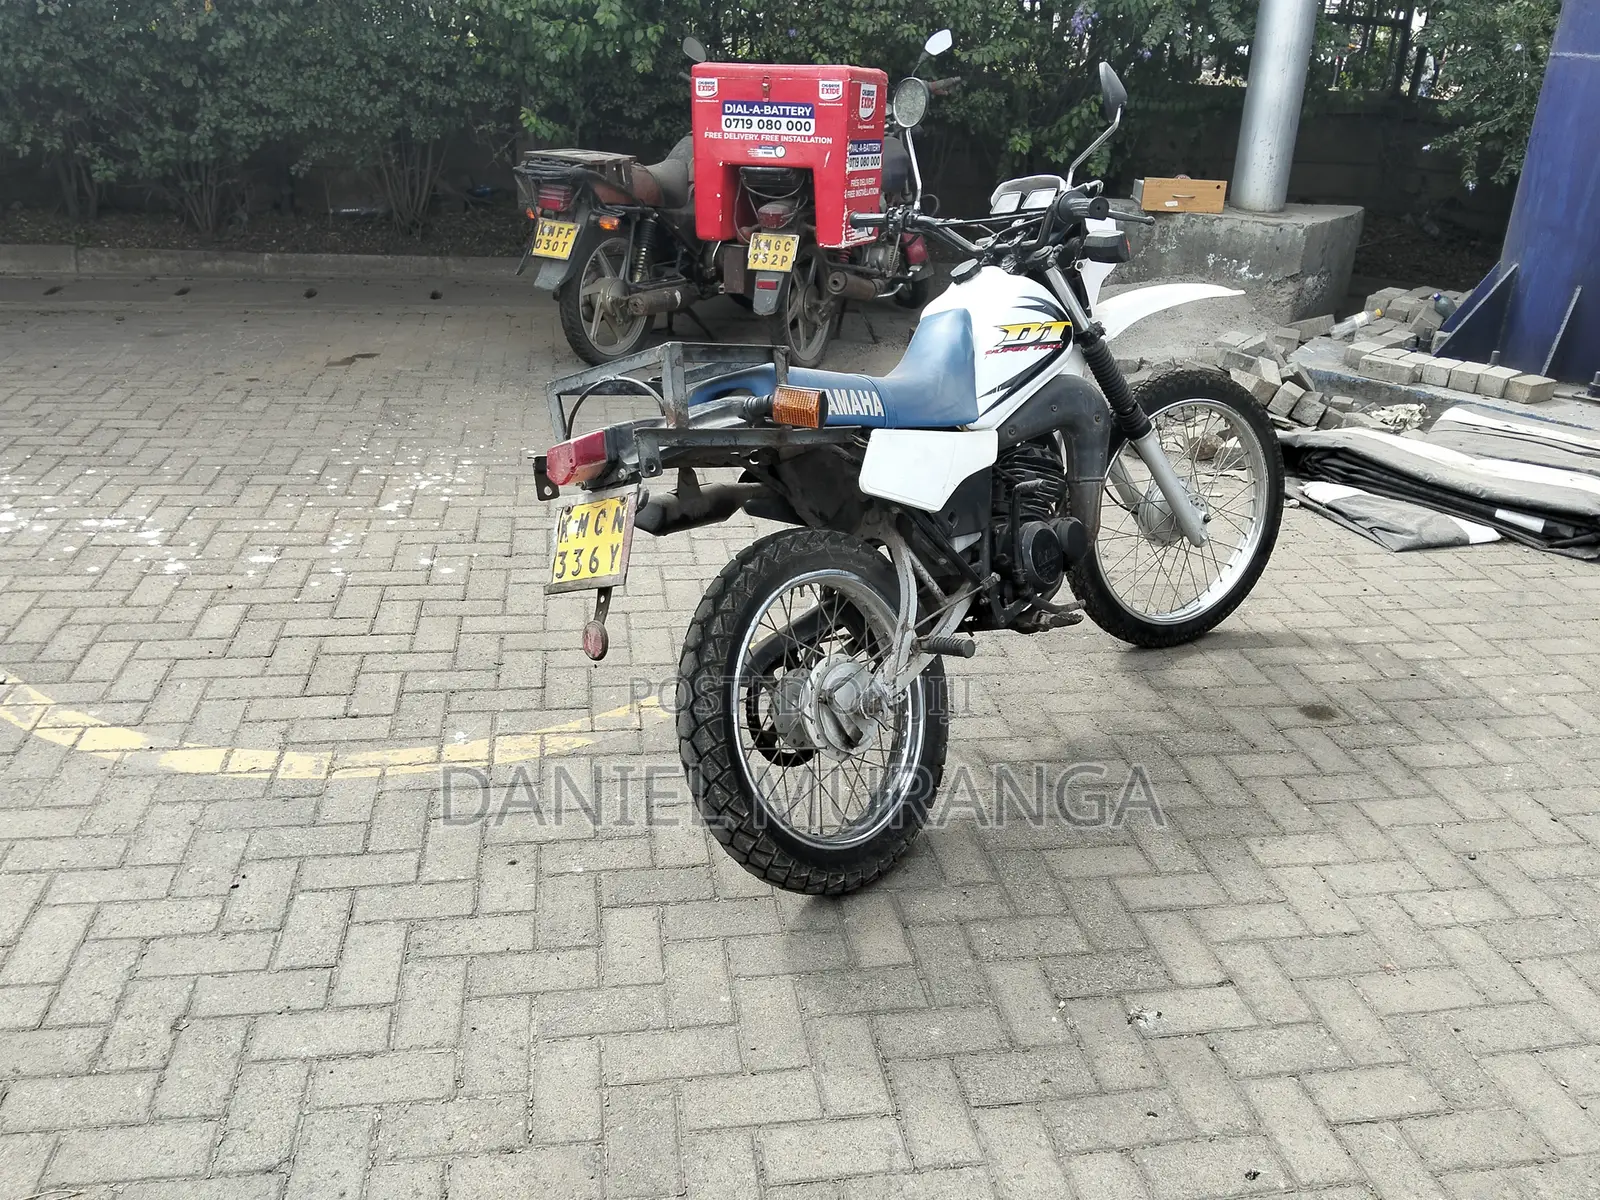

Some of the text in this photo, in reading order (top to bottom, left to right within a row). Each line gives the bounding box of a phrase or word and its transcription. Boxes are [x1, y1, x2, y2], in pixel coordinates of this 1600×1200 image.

[724, 103, 812, 117] DIAL-A-BATTERY
[861, 97, 874, 109] EXIDE
[724, 117, 812, 132] 0719 080 000
[780, 135, 833, 144] INSTALLATION
[849, 155, 880, 168] 0719 080 000
[860, 177, 876, 186] DELIVERY
[847, 187, 879, 198] FREE INSTALLATION
[535, 238, 569, 253] 030T
[752, 252, 788, 267] 952P
[820, 388, 885, 417] AMAHA
[559, 505, 627, 544] KMCN
[555, 543, 621, 580] 336Y
